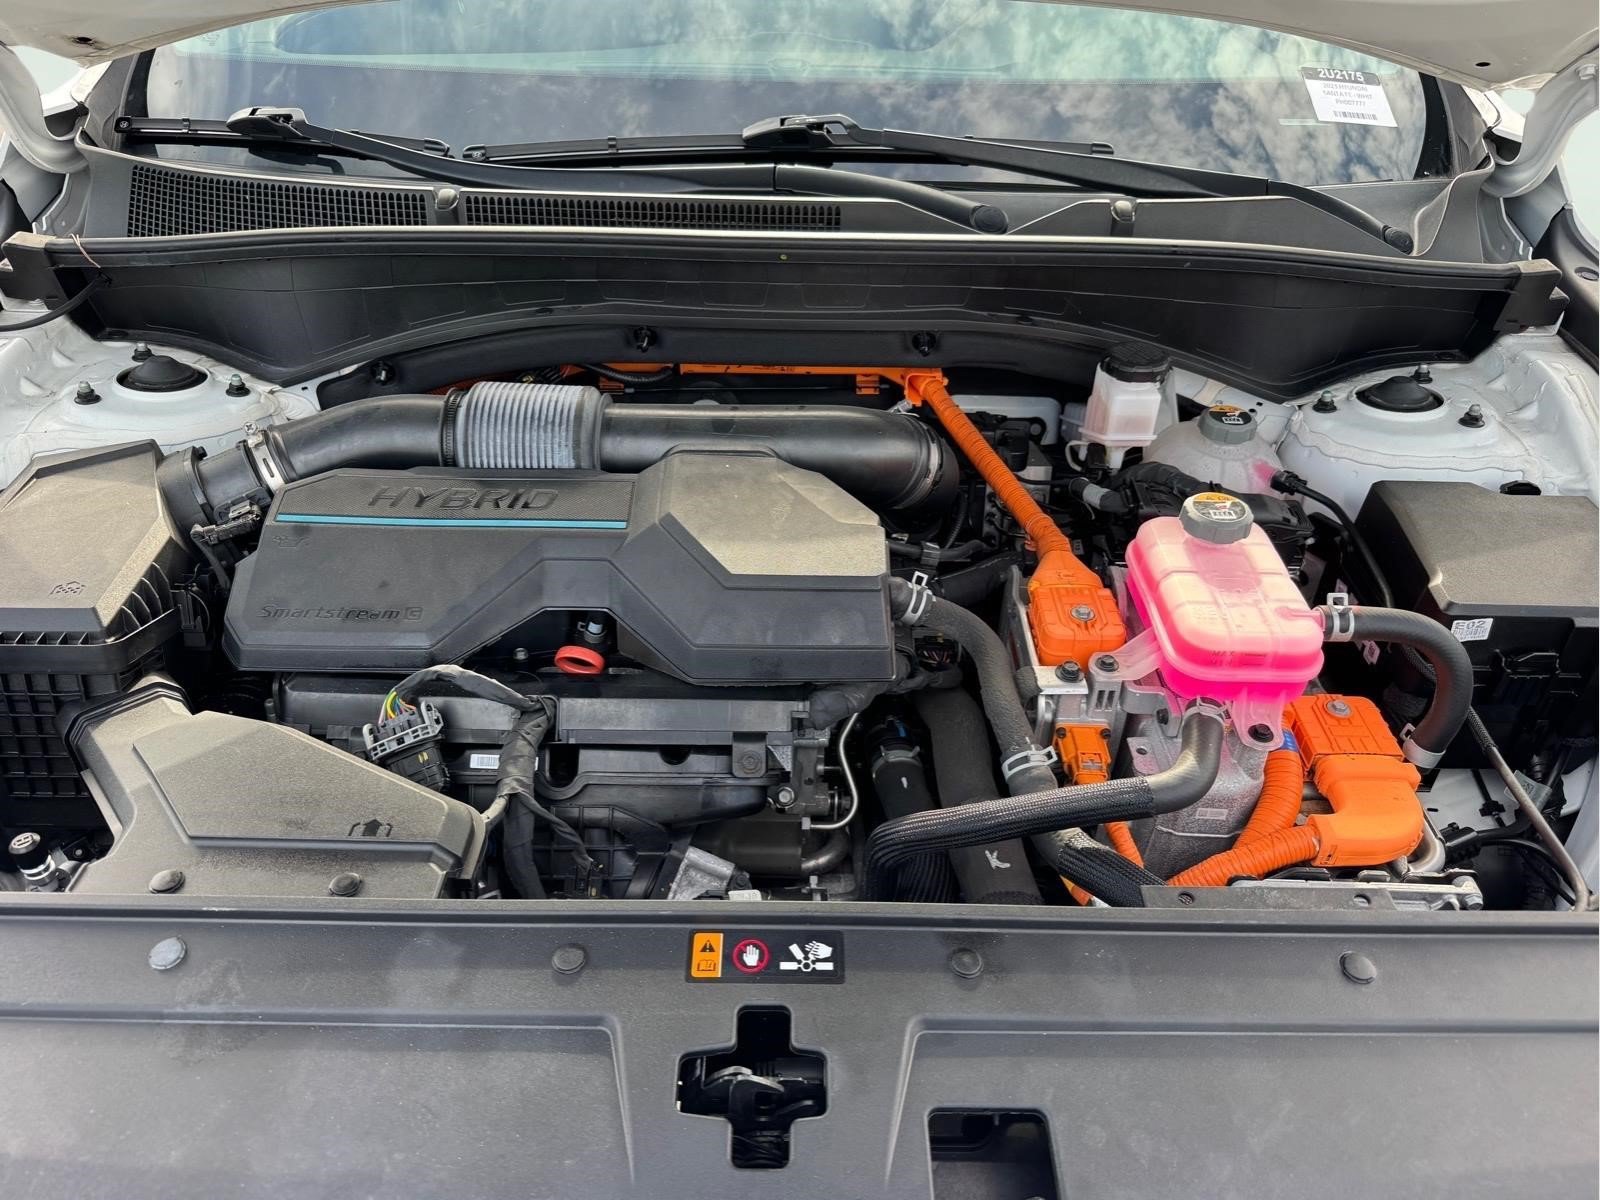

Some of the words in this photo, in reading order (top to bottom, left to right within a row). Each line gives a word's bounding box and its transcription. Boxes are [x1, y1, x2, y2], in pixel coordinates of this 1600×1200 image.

[1317, 68, 1365, 82] 2U2175
[368, 486, 559, 510] HYBRID
[256, 604, 400, 620] Smartstream
